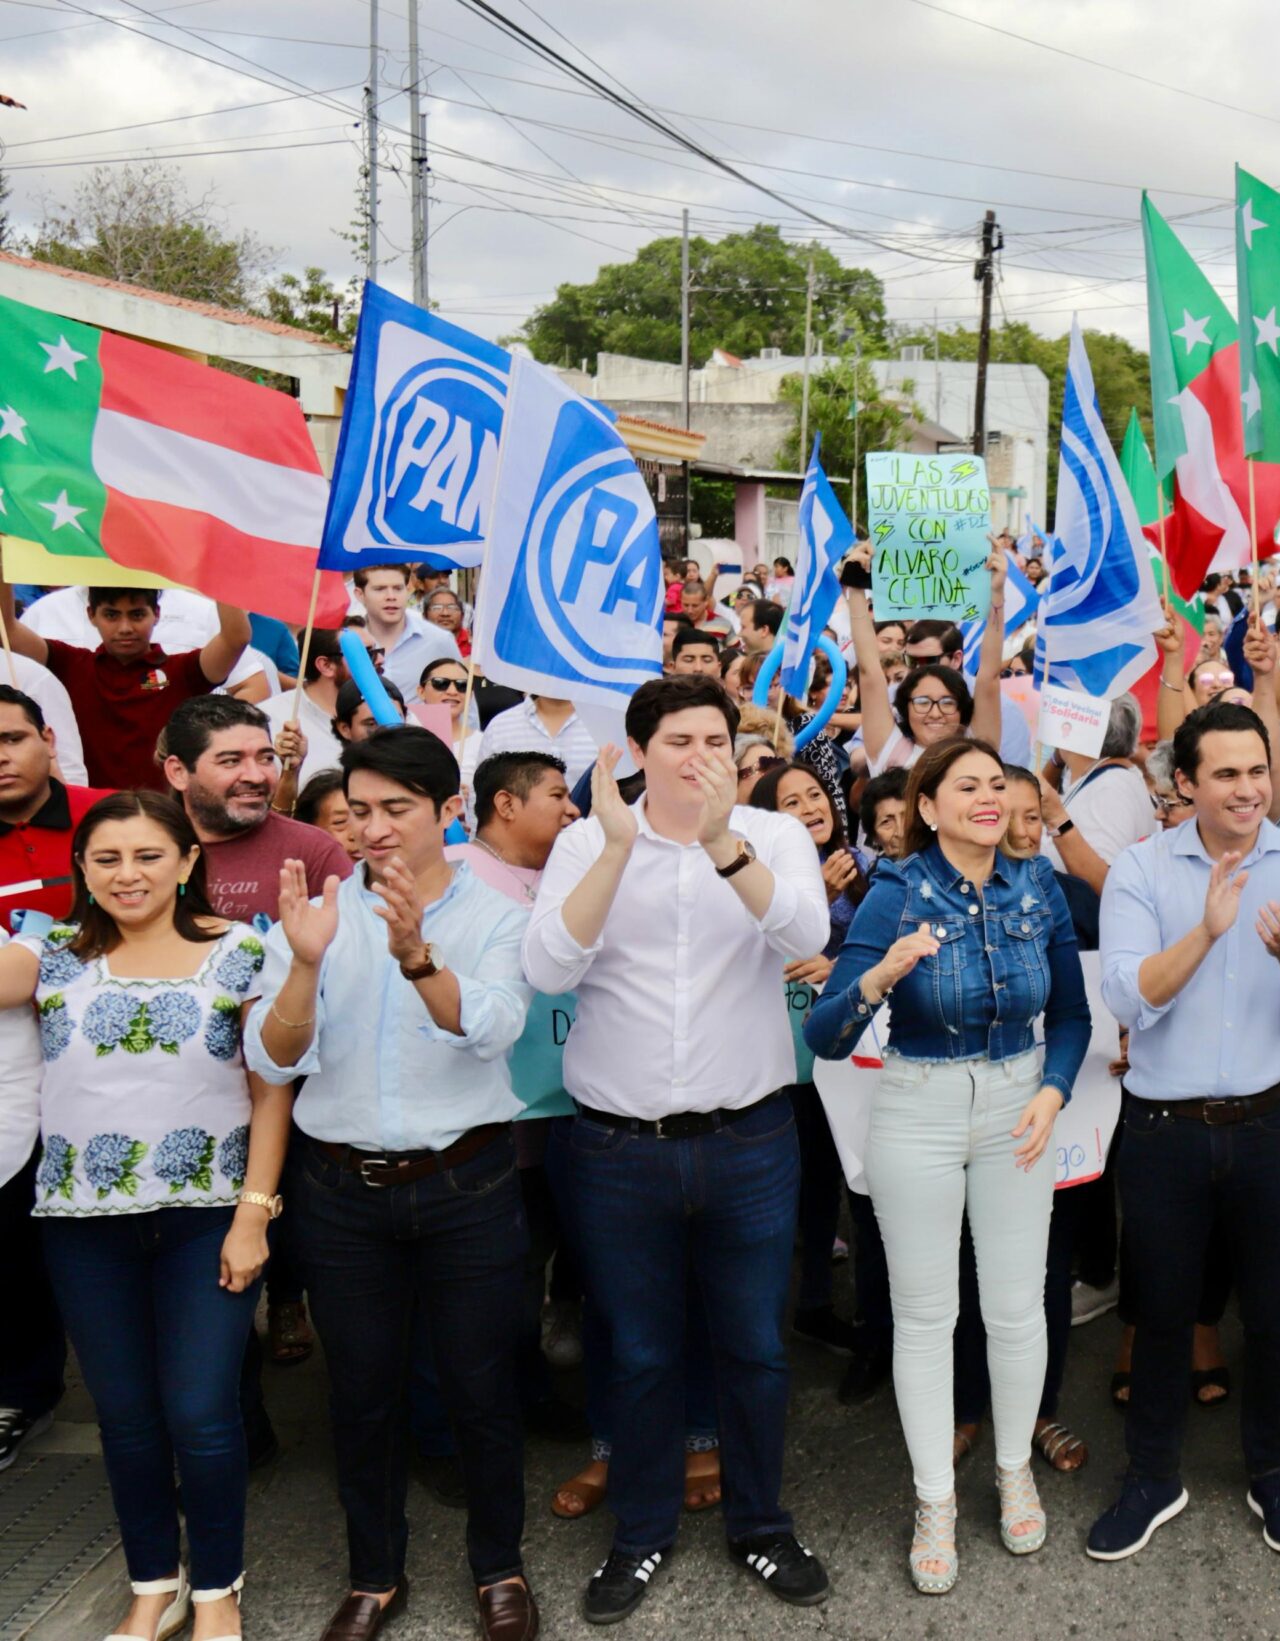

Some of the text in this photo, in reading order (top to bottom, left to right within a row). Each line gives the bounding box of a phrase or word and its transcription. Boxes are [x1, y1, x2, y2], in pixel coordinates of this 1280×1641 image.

[871, 484, 990, 512] JUVENTUDES
[908, 519, 946, 540] CON
[878, 549, 959, 578] ALVARO
[888, 575, 971, 605] CETINA
